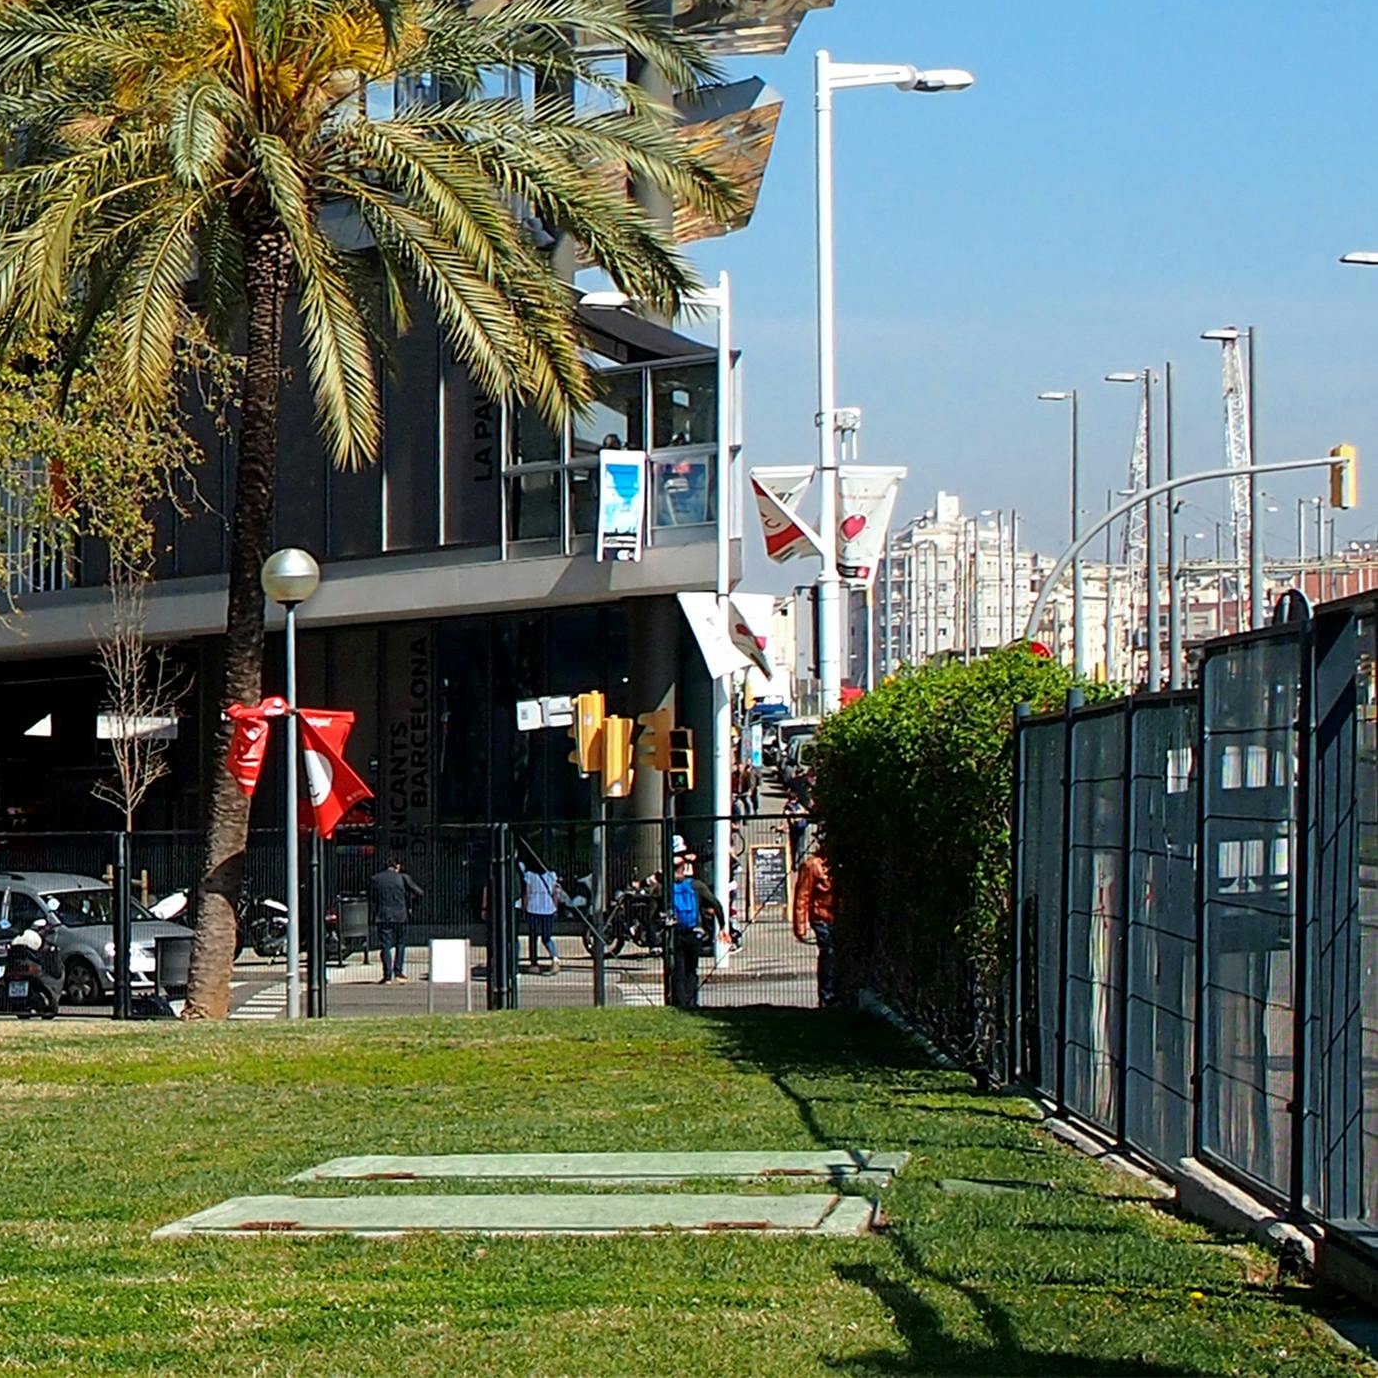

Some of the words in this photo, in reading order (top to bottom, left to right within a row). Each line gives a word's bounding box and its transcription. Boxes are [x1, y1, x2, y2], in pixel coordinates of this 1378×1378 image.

[474, 446, 492, 482] LA
[410, 636, 428, 809] BARCELONA
[390, 721, 408, 851] ENCANTS
[411, 823, 428, 857] DE
